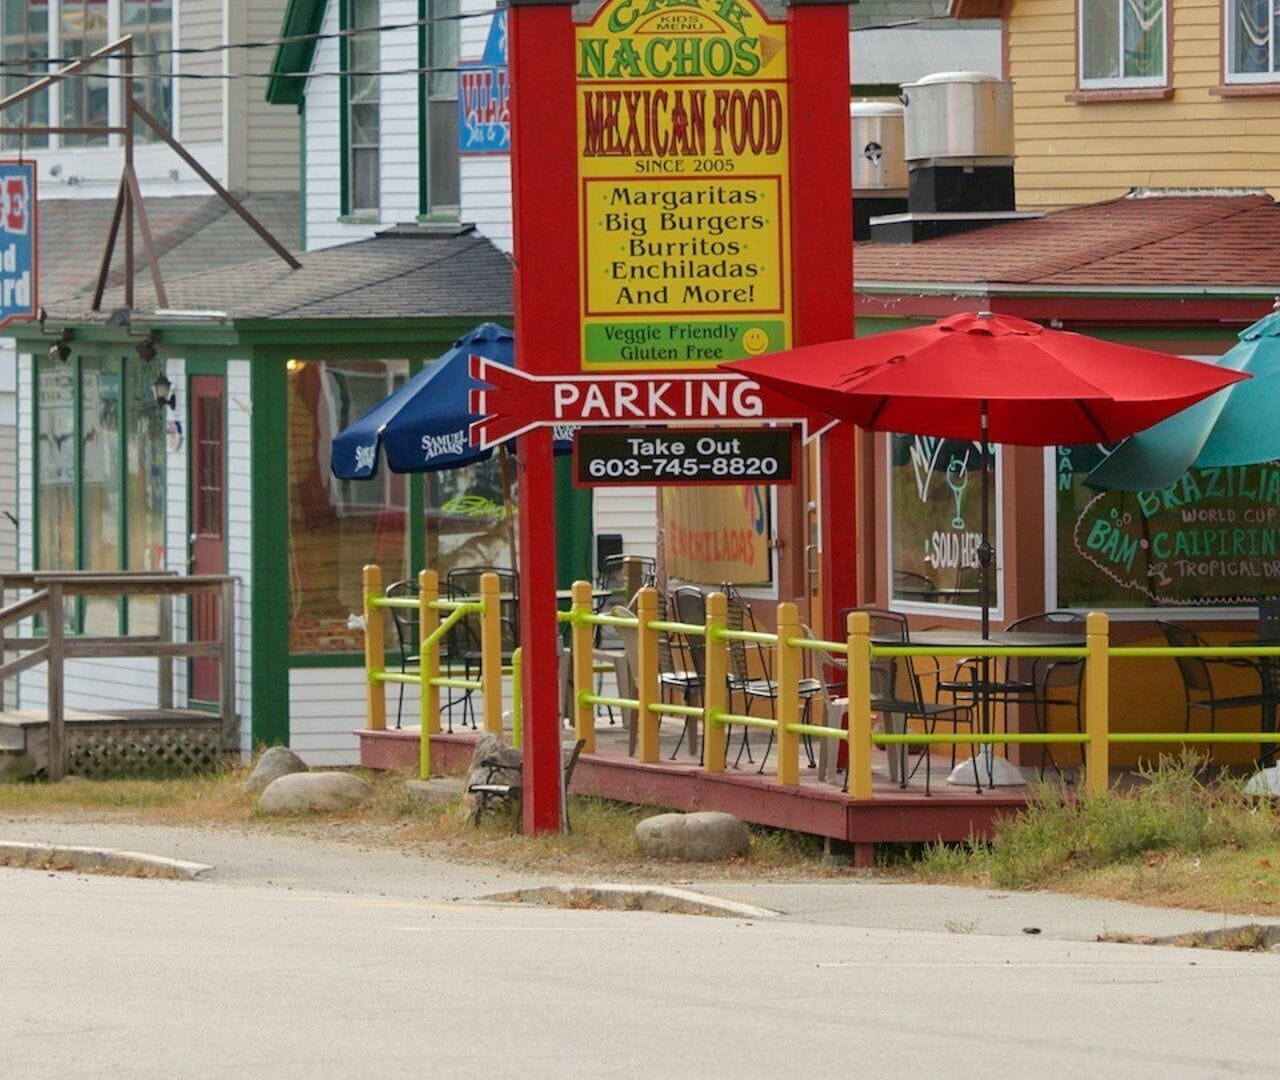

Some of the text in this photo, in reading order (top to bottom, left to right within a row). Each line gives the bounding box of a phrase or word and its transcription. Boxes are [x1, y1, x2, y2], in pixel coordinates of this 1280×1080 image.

[656, 23, 703, 31] MENU
[660, 15, 699, 23] KIDS
[577, 37, 762, 78] NACHOS
[583, 89, 707, 158] MEXICAN
[713, 88, 782, 155] FOOD
[635, 158, 734, 173] SINCE 2005
[610, 186, 758, 210] Margaritas
[605, 212, 764, 236] Big Burgers
[629, 238, 740, 257] Burritos
[612, 259, 758, 280] Enchiladas
[616, 285, 755, 304] And More!
[604, 324, 739, 344] Veggie Friendly
[621, 346, 723, 361] Gluten Free
[553, 381, 764, 418] PARKING
[421, 430, 468, 450] SAMUEL
[627, 437, 740, 457] Take Out
[425, 442, 463, 462] ADAMS
[589, 457, 778, 477] 603-745-8820
[1181, 508, 1276, 523] WORLD CUP
[931, 531, 984, 570] SOLD HER
[1087, 518, 1141, 573] BAM
[1175, 560, 1261, 579] TROPICAL
